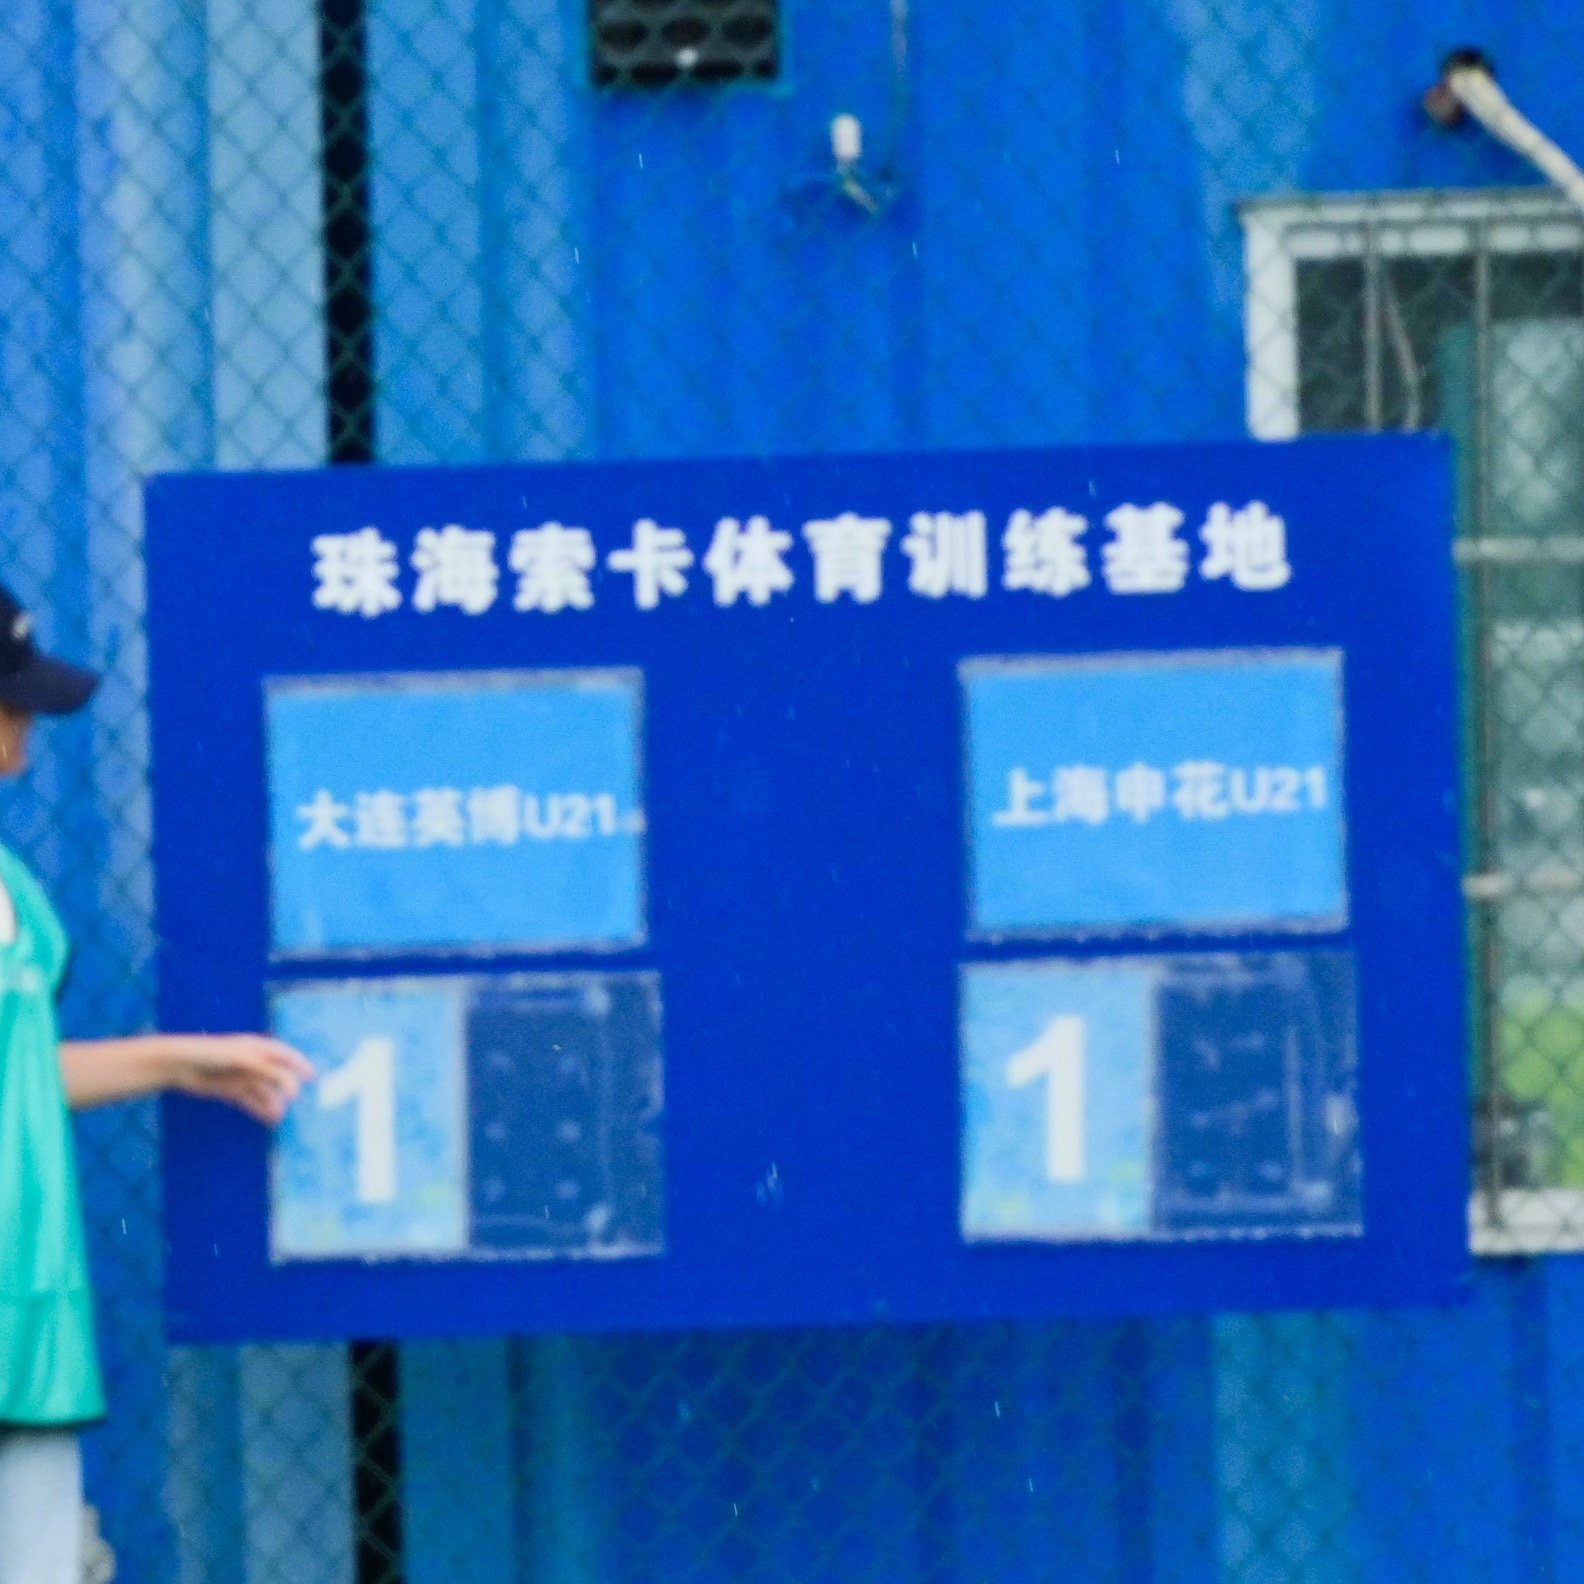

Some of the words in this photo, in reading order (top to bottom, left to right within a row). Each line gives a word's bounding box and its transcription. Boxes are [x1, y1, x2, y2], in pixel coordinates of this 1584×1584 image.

[312, 502, 1291, 617] 珠海索卡体育训练基地
[296, 784, 620, 850] 大连英博U21
[992, 760, 1327, 827] 上海申花U21
[316, 1038, 394, 1204] 1
[1007, 1016, 1084, 1182] 1
